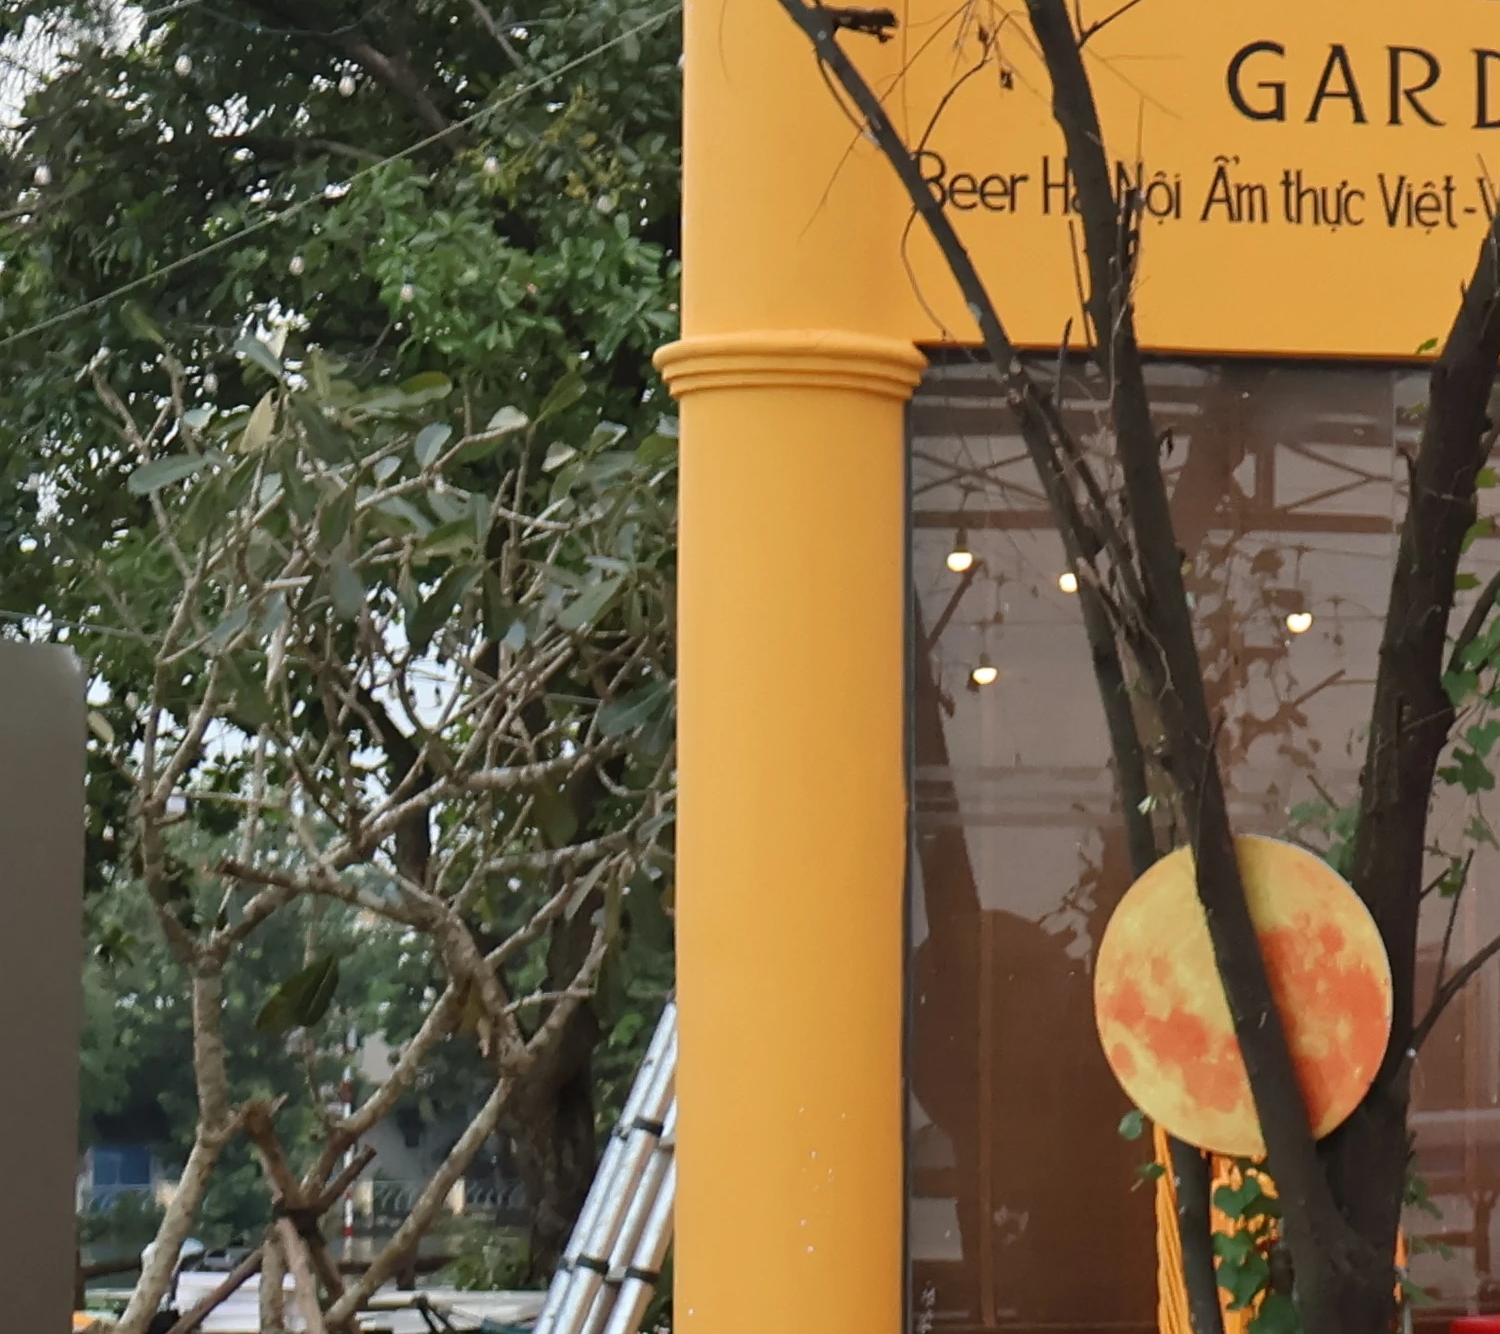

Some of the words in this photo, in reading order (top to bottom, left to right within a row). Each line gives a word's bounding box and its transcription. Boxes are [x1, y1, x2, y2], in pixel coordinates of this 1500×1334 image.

[910, 150, 1029, 214] Beer
[1200, 155, 1268, 224] Ẩm
[1283, 169, 1365, 232] thực
